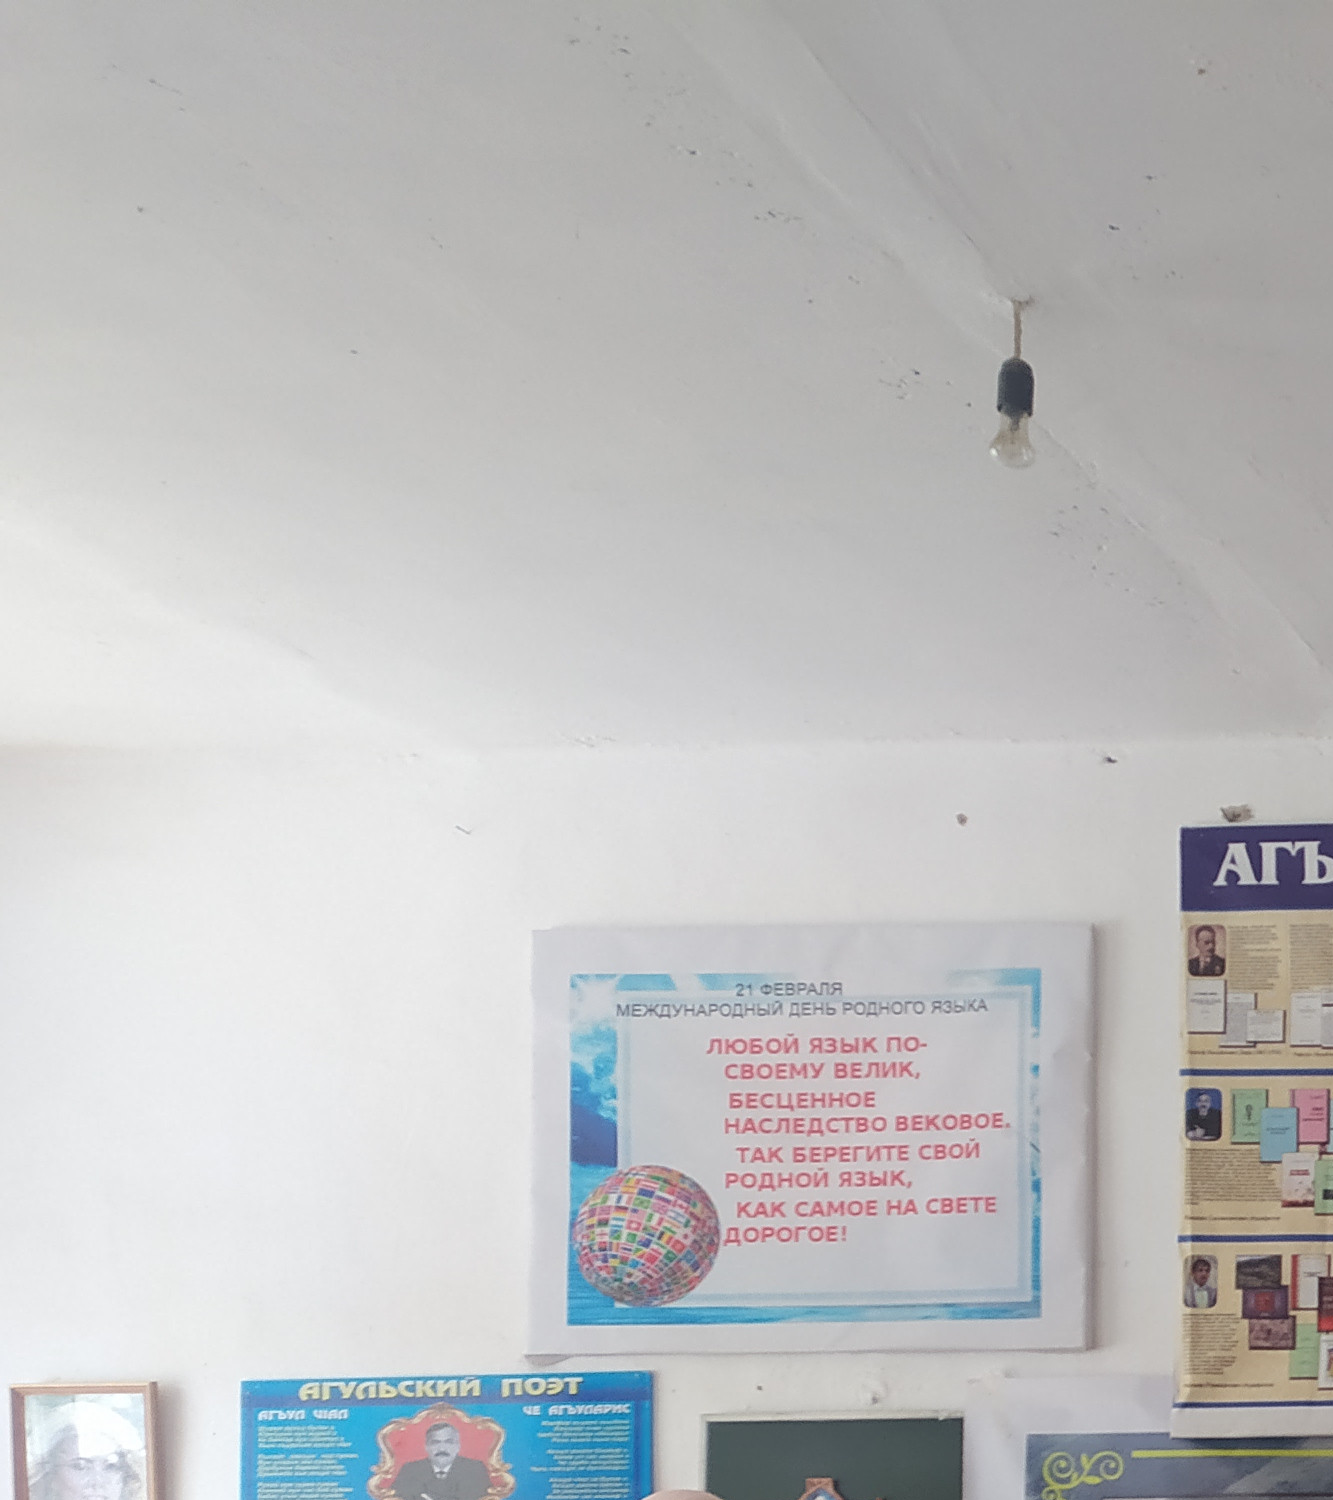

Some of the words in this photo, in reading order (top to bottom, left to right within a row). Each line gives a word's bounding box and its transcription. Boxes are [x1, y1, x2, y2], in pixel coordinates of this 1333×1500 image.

[736, 984, 754, 997] 21
[760, 982, 842, 996] ФЕВРАЛЯ
[616, 1001, 782, 1019] МЕЖДУНАРОДНЫЙ
[789, 1003, 836, 1018] ДЕНЬ
[842, 1001, 924, 1017] РОДНОГО
[931, 999, 988, 1014] ЯЗЫКА
[706, 1034, 799, 1055] ЛЮБОЙ
[809, 1038, 878, 1053] ЯЗЫК
[886, 1037, 927, 1052] ПО-
[724, 1063, 824, 1080] СВОЕМУ
[834, 1062, 921, 1079] ВЕЛИК,
[729, 1092, 876, 1111] БЕСЦЕННОЕ
[724, 1117, 887, 1136] НАСЛЕДСТВО
[895, 1112, 1010, 1132] ВЕКОВОЕ.
[736, 1147, 784, 1163] ТАК
[792, 1145, 909, 1162] БЕРЕГИТЕ
[918, 1138, 980, 1160] СВОЙ
[725, 1168, 829, 1190] РОДНОЙ
[839, 1170, 912, 1188] ЯЗЫК,
[736, 1202, 786, 1218] КАК
[795, 1200, 878, 1216] САМОЕ
[886, 1199, 918, 1215] НА
[926, 1197, 996, 1214] СВЕТЕ
[724, 1226, 847, 1246] ДОРОГОЕ!
[299, 1378, 481, 1401] АГУЛЬСКИЙ
[501, 1377, 583, 1397] ПОЭТ
